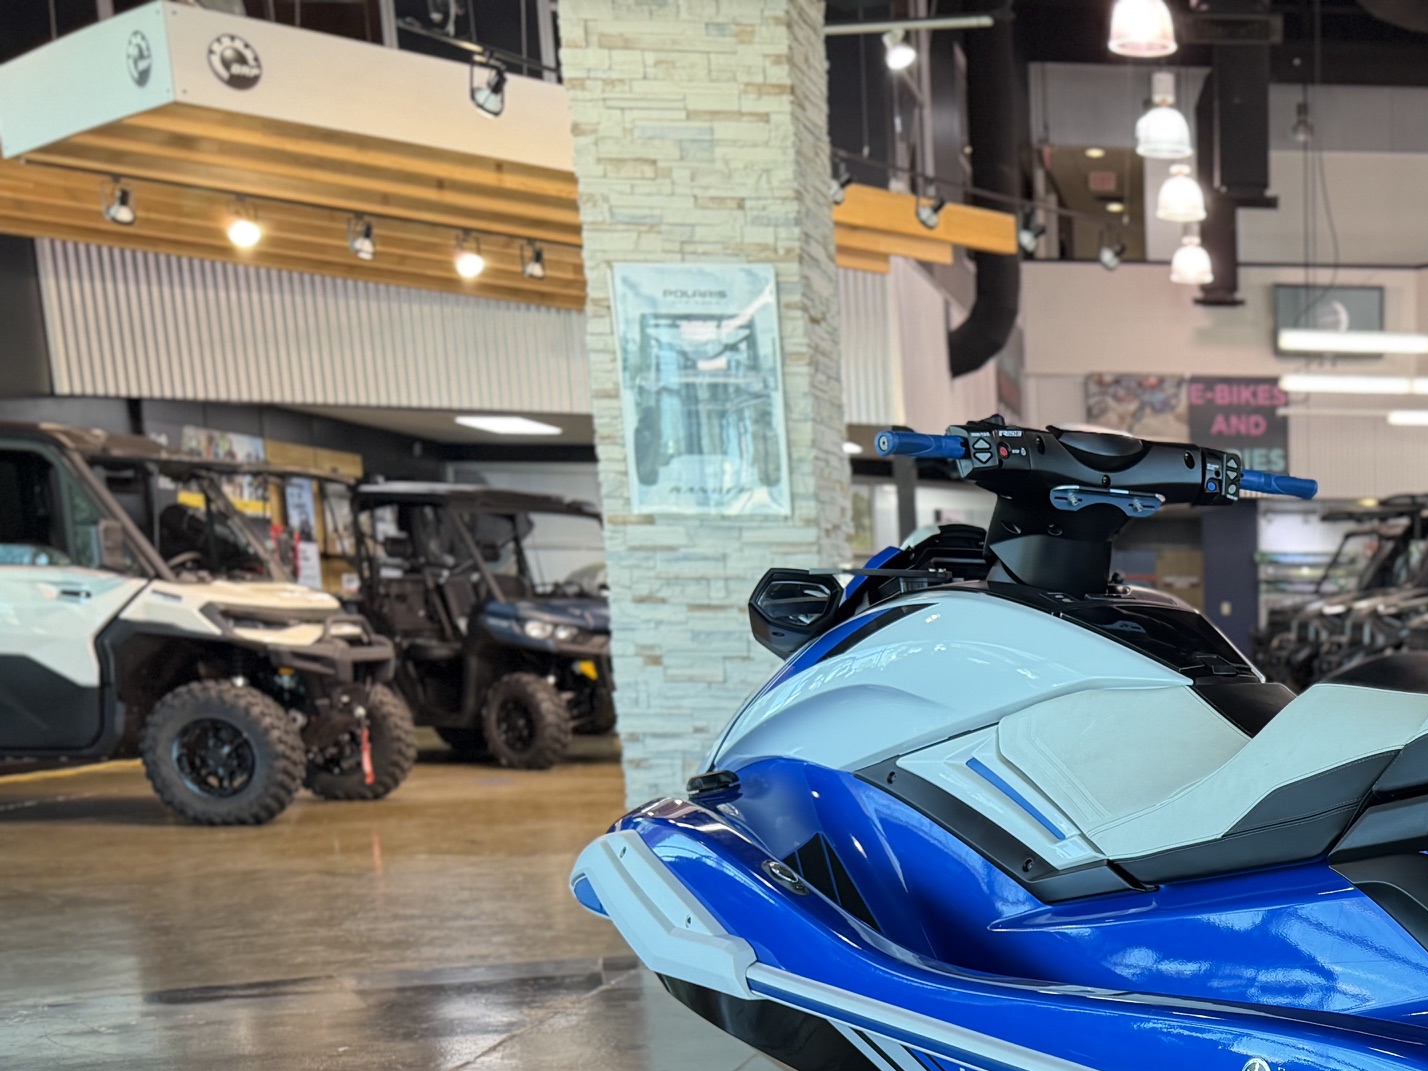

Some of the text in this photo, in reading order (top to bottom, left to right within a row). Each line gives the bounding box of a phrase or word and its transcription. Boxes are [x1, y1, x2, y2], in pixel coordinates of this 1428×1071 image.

[662, 289, 727, 299] POLARIS
[1189, 383, 1288, 406] E-BIKES
[1210, 414, 1268, 437] AND
